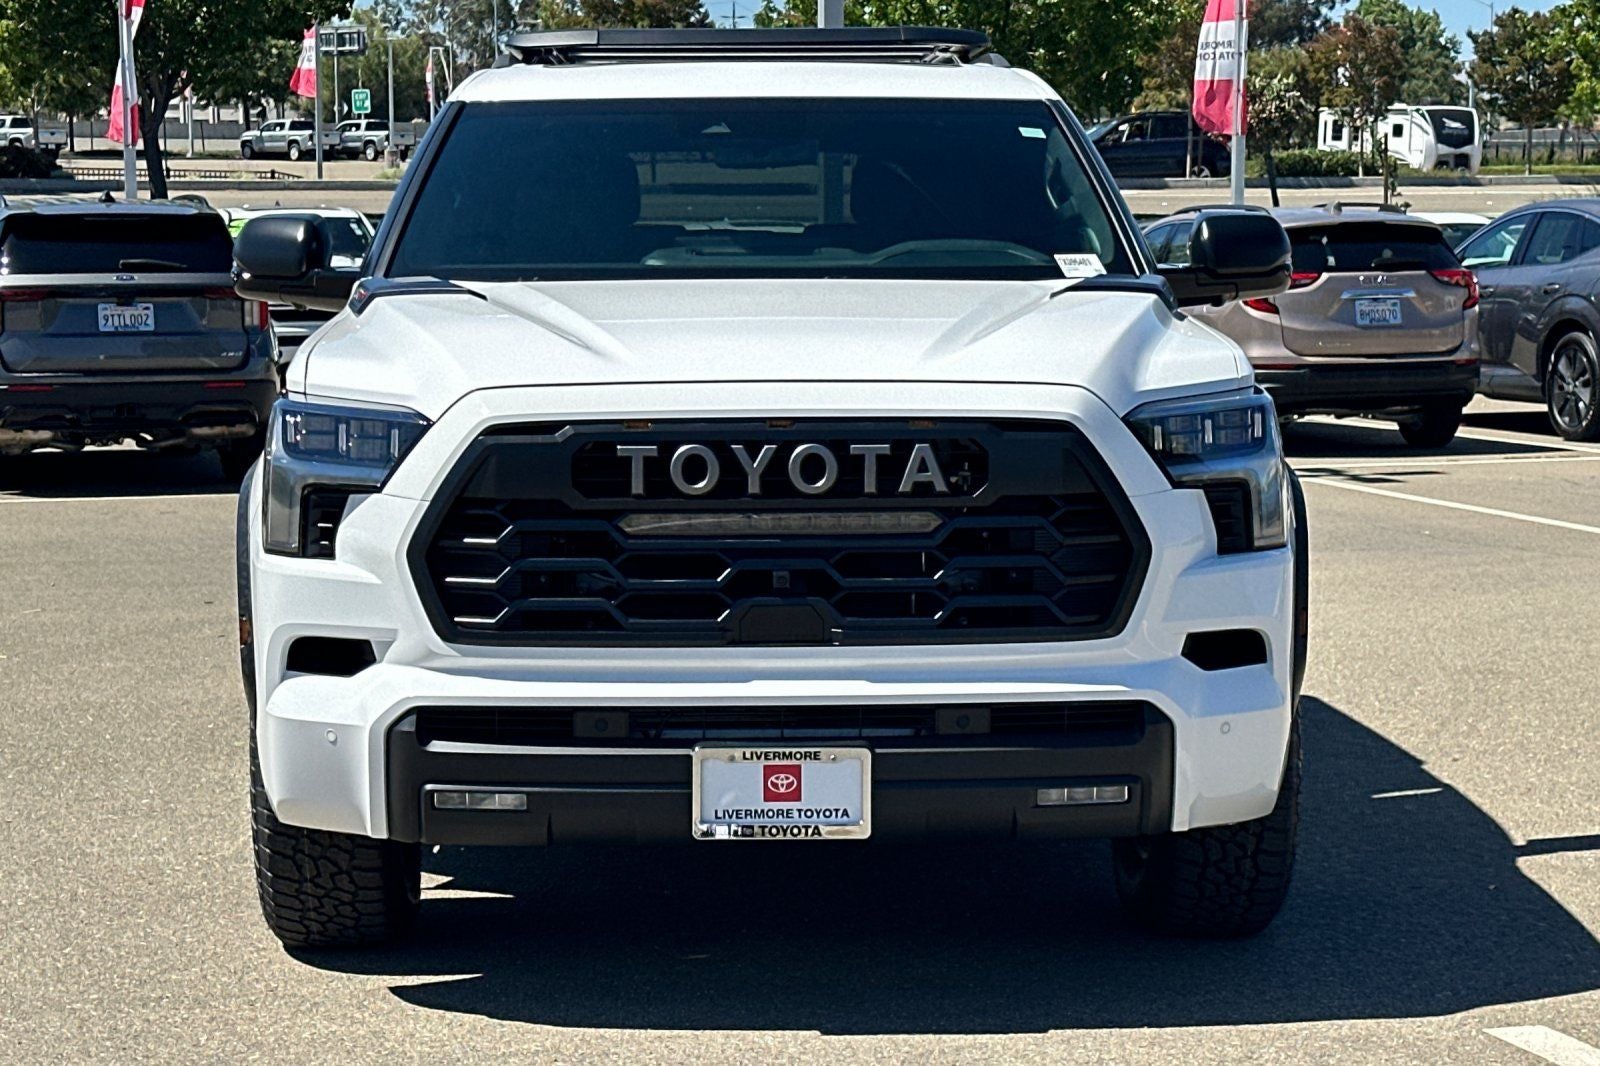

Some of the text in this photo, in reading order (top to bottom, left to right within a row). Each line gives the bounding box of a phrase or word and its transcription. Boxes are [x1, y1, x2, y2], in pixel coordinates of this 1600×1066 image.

[616, 443, 950, 496] TOYOTA
[742, 751, 821, 761] LIVERMORE
[714, 808, 850, 820] LIVERMORE TOYOTA
[758, 825, 823, 838] TOYOTA
